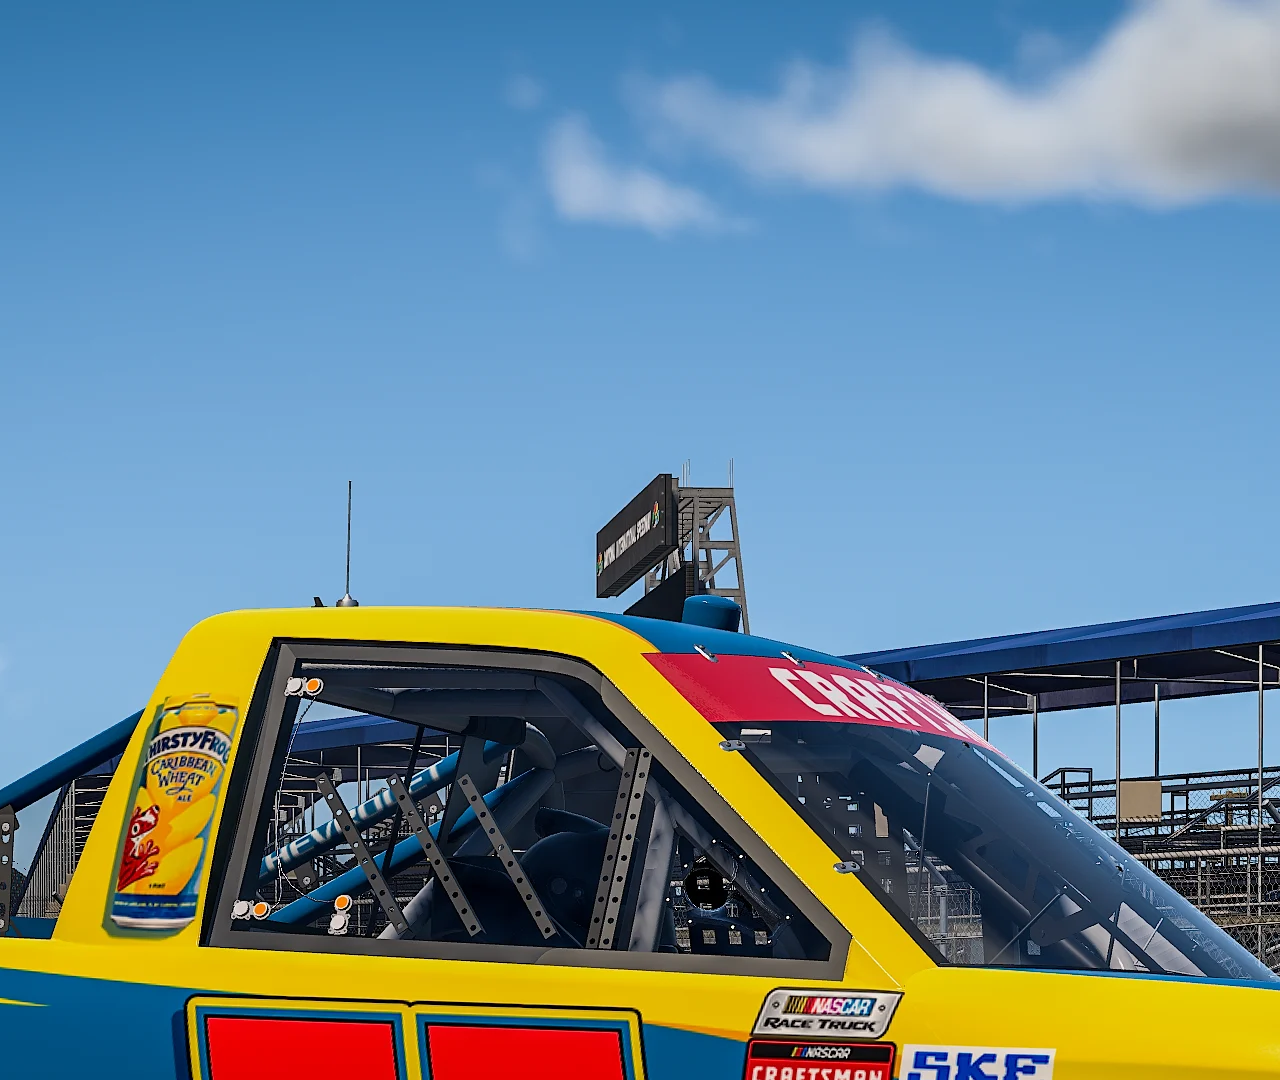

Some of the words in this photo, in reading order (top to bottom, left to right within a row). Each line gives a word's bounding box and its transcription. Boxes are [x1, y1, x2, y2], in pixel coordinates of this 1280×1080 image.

[158, 770, 205, 789] WHEAT
[811, 997, 872, 1015] NASCAR
[763, 1017, 813, 1029] RACE
[819, 1019, 877, 1032] TRUCK
